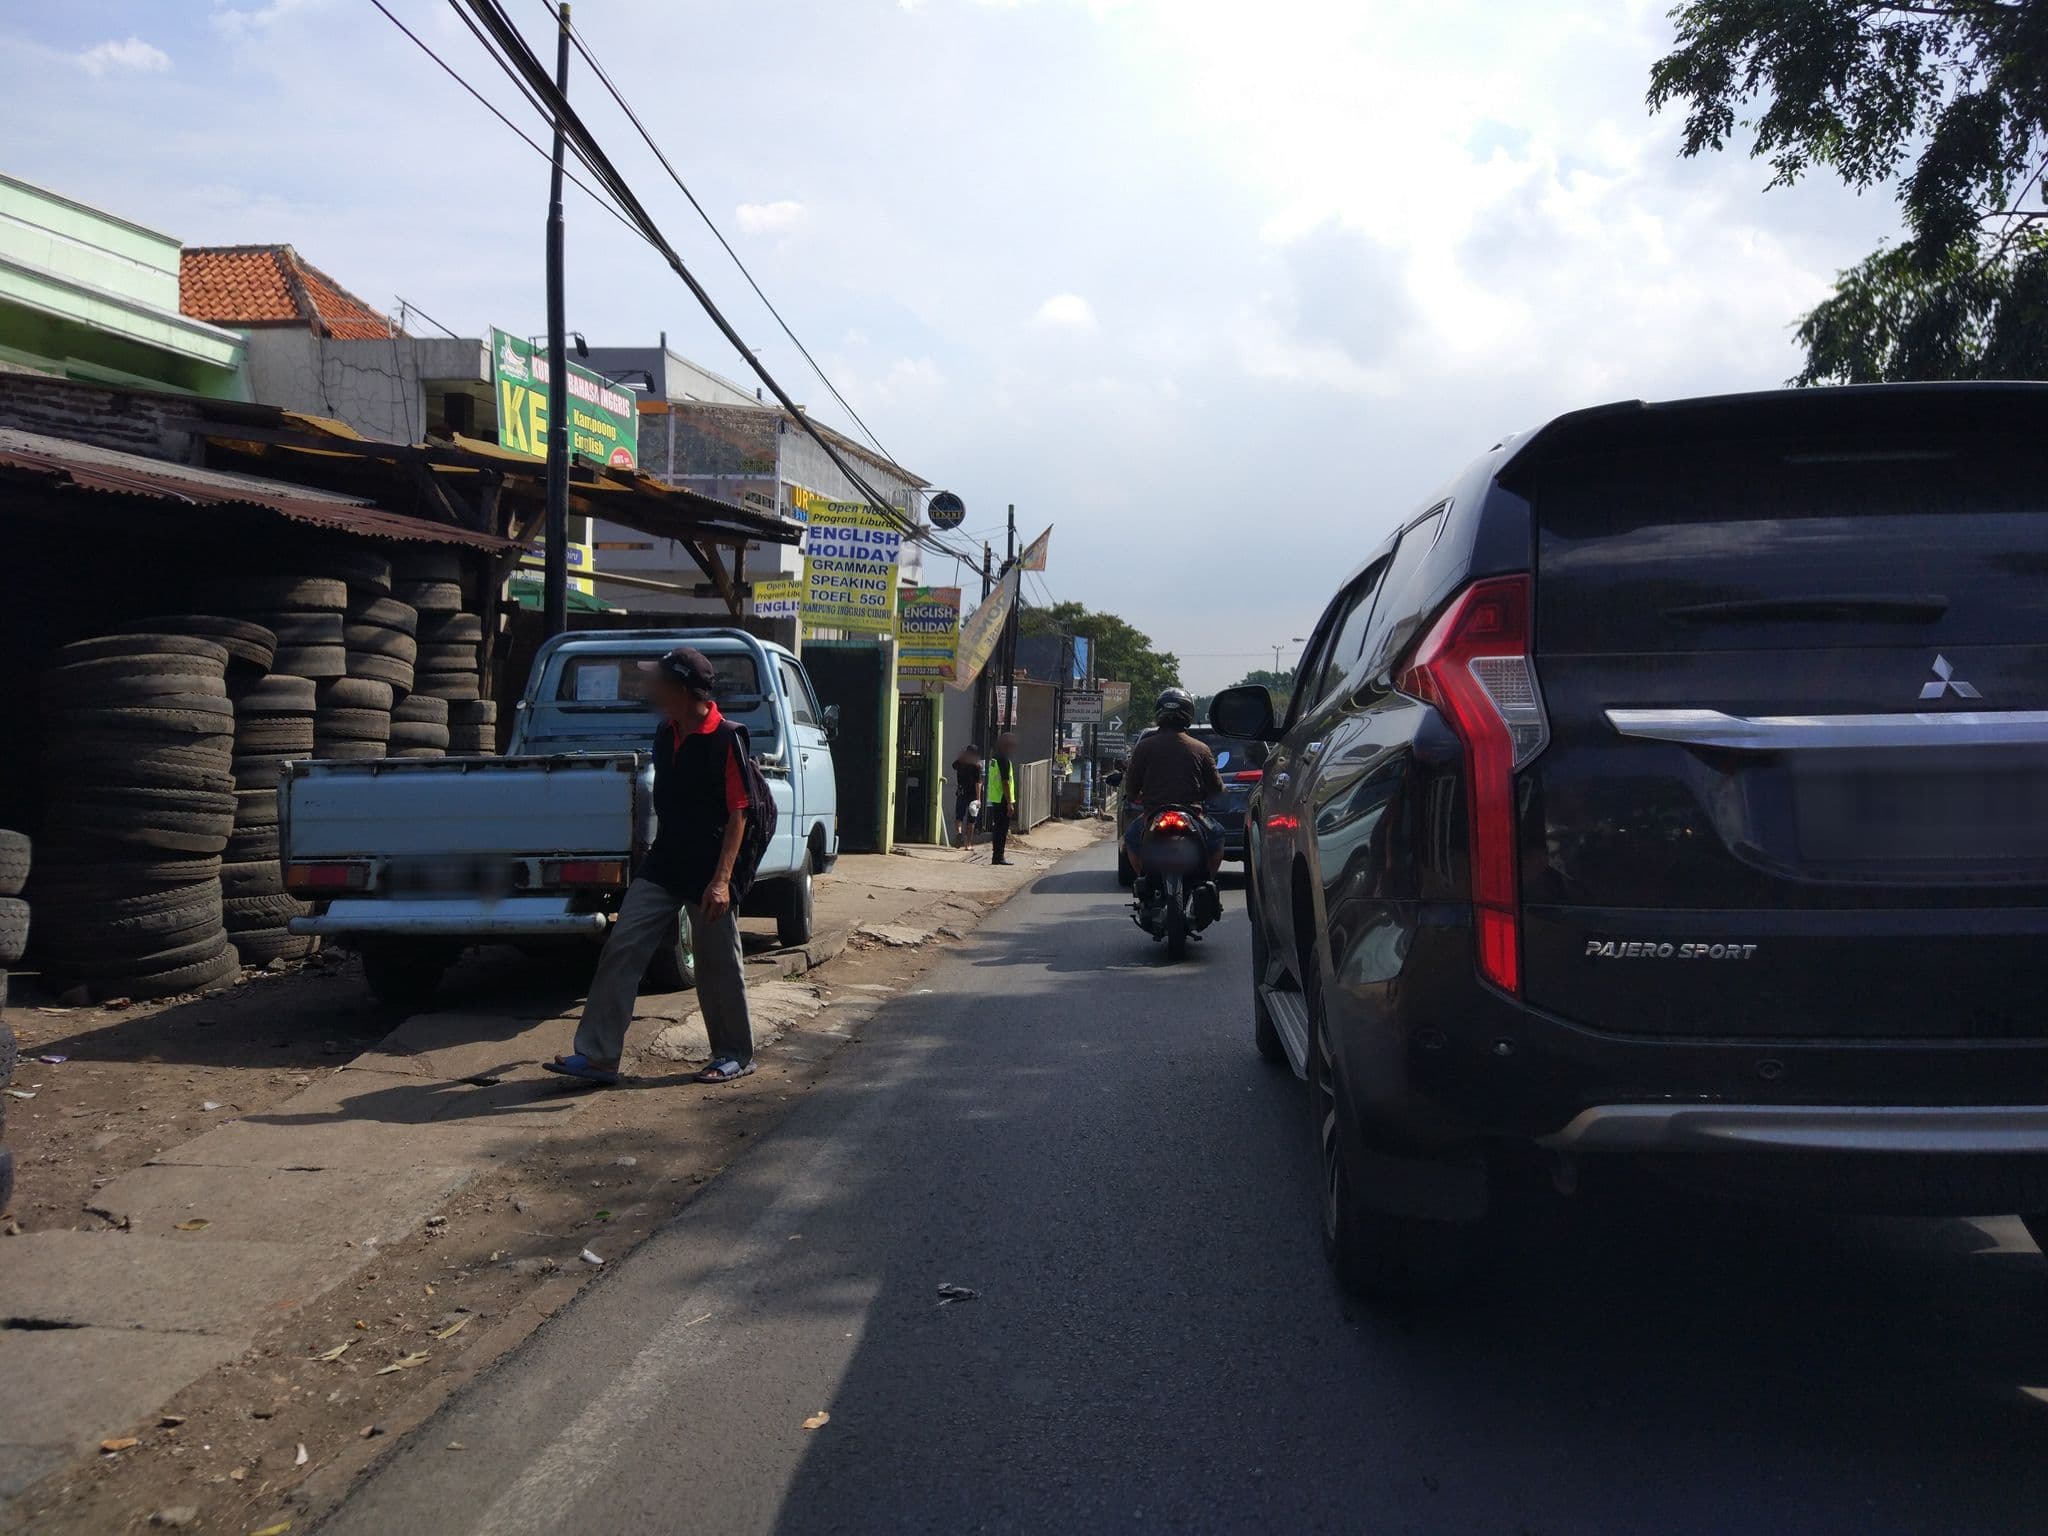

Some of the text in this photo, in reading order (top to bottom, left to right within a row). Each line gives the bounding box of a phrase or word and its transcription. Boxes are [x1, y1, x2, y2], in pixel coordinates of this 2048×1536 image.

[567, 371, 601, 405] BAHASA
[600, 387, 631, 418] INGGRIS
[502, 379, 548, 460] KE
[573, 408, 617, 441] Kampoong
[574, 431, 604, 456] English
[827, 502, 859, 514] Open
[813, 513, 857, 525] Program
[810, 526, 900, 547] ENGLISH
[807, 543, 899, 563] HOLIDAY
[812, 559, 889, 576] GRAMMAR
[766, 582, 786, 591] Open
[811, 575, 887, 592] SPEAKING
[809, 589, 855, 604] TOEFL
[860, 593, 886, 606] 550
[802, 603, 836, 614] KAMPUNG
[838, 606, 866, 617] INGGRIS
[867, 608, 891, 619] CIBIRU
[904, 606, 953, 619] ENGLISH
[901, 620, 953, 633] HOLIDAY
[1585, 940, 1758, 960] PAJERO SPORT
